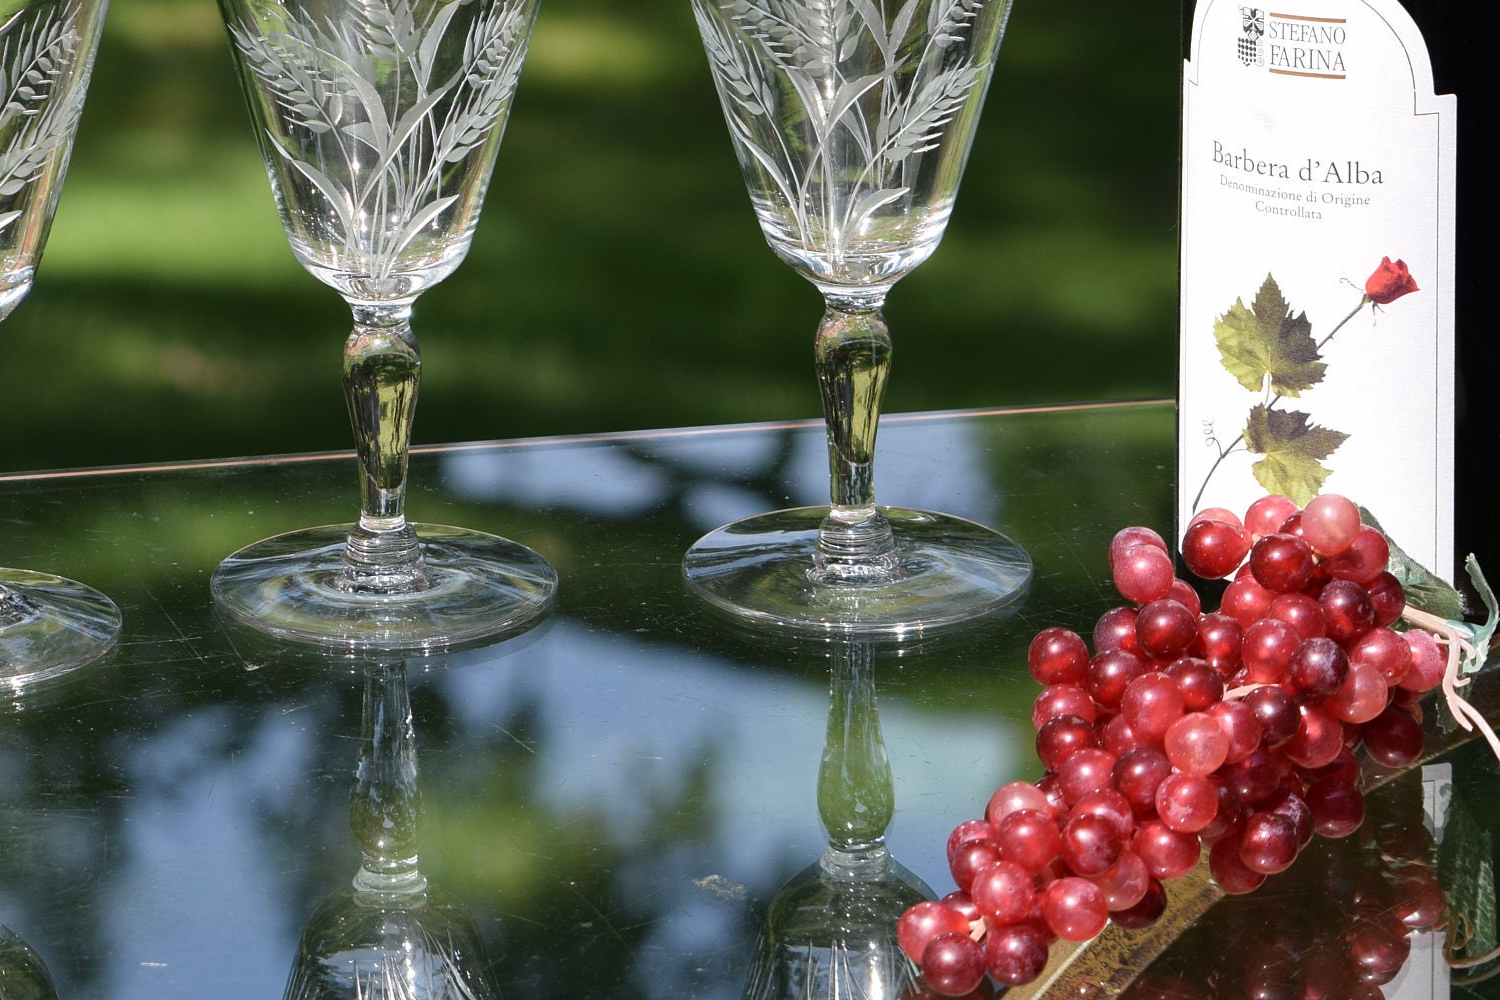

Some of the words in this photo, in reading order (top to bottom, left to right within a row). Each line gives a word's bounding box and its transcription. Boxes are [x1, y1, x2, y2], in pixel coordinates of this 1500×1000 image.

[1268, 21, 1346, 45] STEFANO
[1269, 44, 1347, 72] FARINA
[1212, 139, 1290, 180] Barbera
[1298, 158, 1384, 185] d'Alba
[1219, 173, 1303, 202] Denominazione
[1306, 190, 1318, 203] di
[1321, 192, 1371, 209] Origine
[1255, 199, 1322, 220] Controllata
